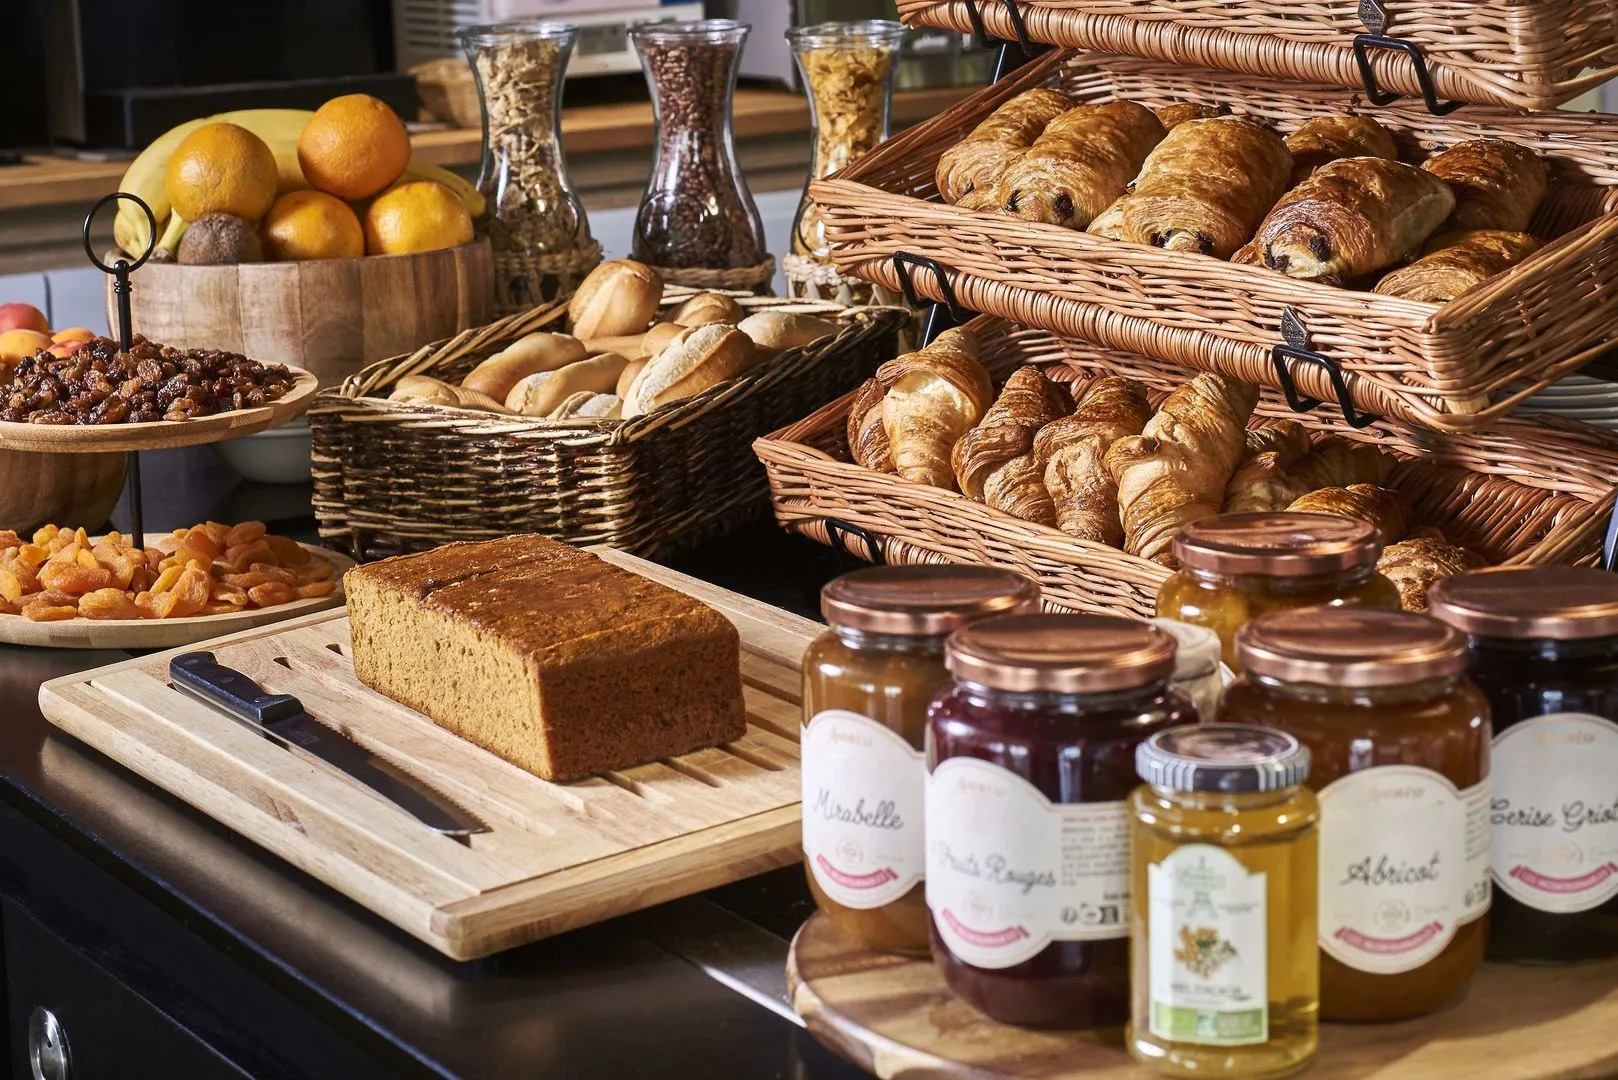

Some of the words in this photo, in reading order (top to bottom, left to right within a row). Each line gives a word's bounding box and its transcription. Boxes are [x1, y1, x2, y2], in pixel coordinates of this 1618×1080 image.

[814, 787, 904, 830] Mirabelle
[1490, 797, 1556, 828] Cerise
[985, 853, 1057, 895] Rouges
[1340, 850, 1441, 887] Abricot
